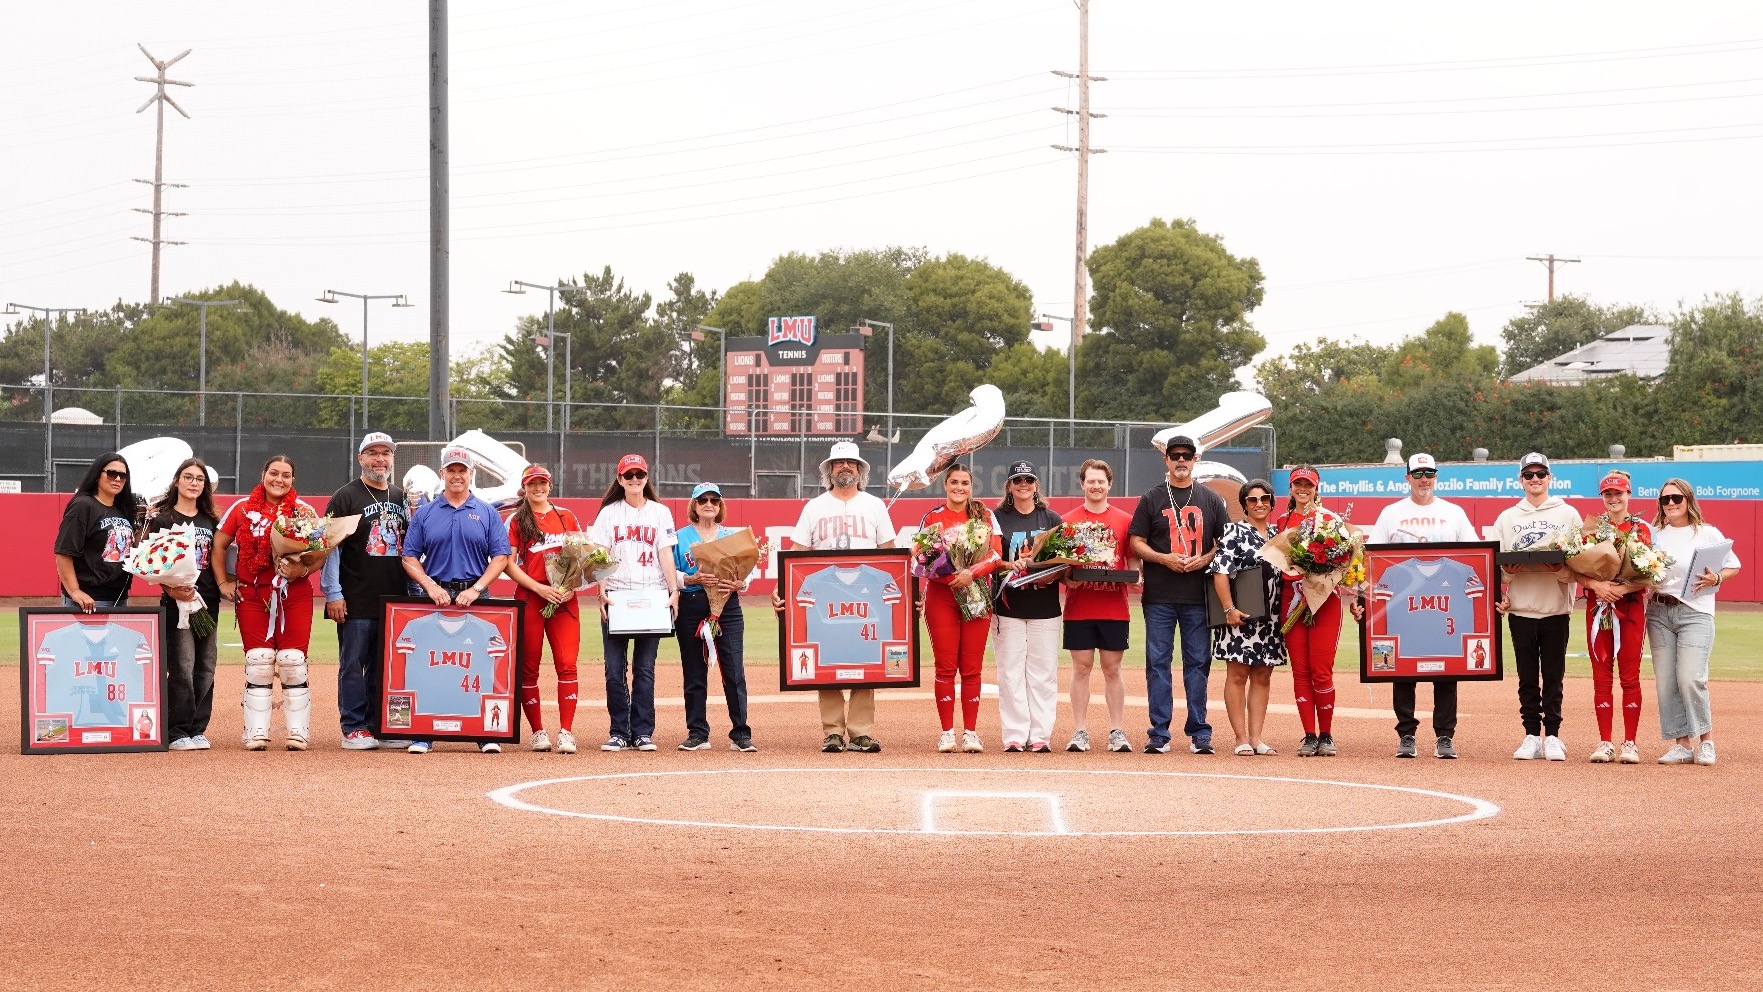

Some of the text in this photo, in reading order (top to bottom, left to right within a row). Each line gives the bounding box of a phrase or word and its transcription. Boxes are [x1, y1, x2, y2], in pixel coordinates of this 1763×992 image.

[768, 316, 816, 346] LMU
[734, 356, 754, 366] LIONS
[778, 350, 806, 358] TENNIS
[822, 354, 842, 364] VISITORS
[818, 374, 834, 382] LIONS
[448, 451, 467, 460] LMU
[1318, 482, 1336, 492] The
[1338, 480, 1370, 494] Phyllis
[1372, 482, 1384, 492] &
[1434, 478, 1464, 490] ozilo
[1466, 478, 1504, 492] Family
[1638, 486, 1659, 496] Betty
[1696, 486, 1760, 498] Bob Forgnone
[613, 525, 657, 546] LMU
[818, 515, 868, 541] O'DELL
[1512, 520, 1536, 534] Dust
[827, 602, 870, 619] LMU
[1408, 596, 1450, 613] LMU
[860, 623, 878, 641] 41
[1446, 617, 1455, 636] 3
[428, 650, 472, 670] LMU
[74, 660, 117, 679] LMU
[460, 674, 480, 693] 44
[107, 683, 126, 702] 88
